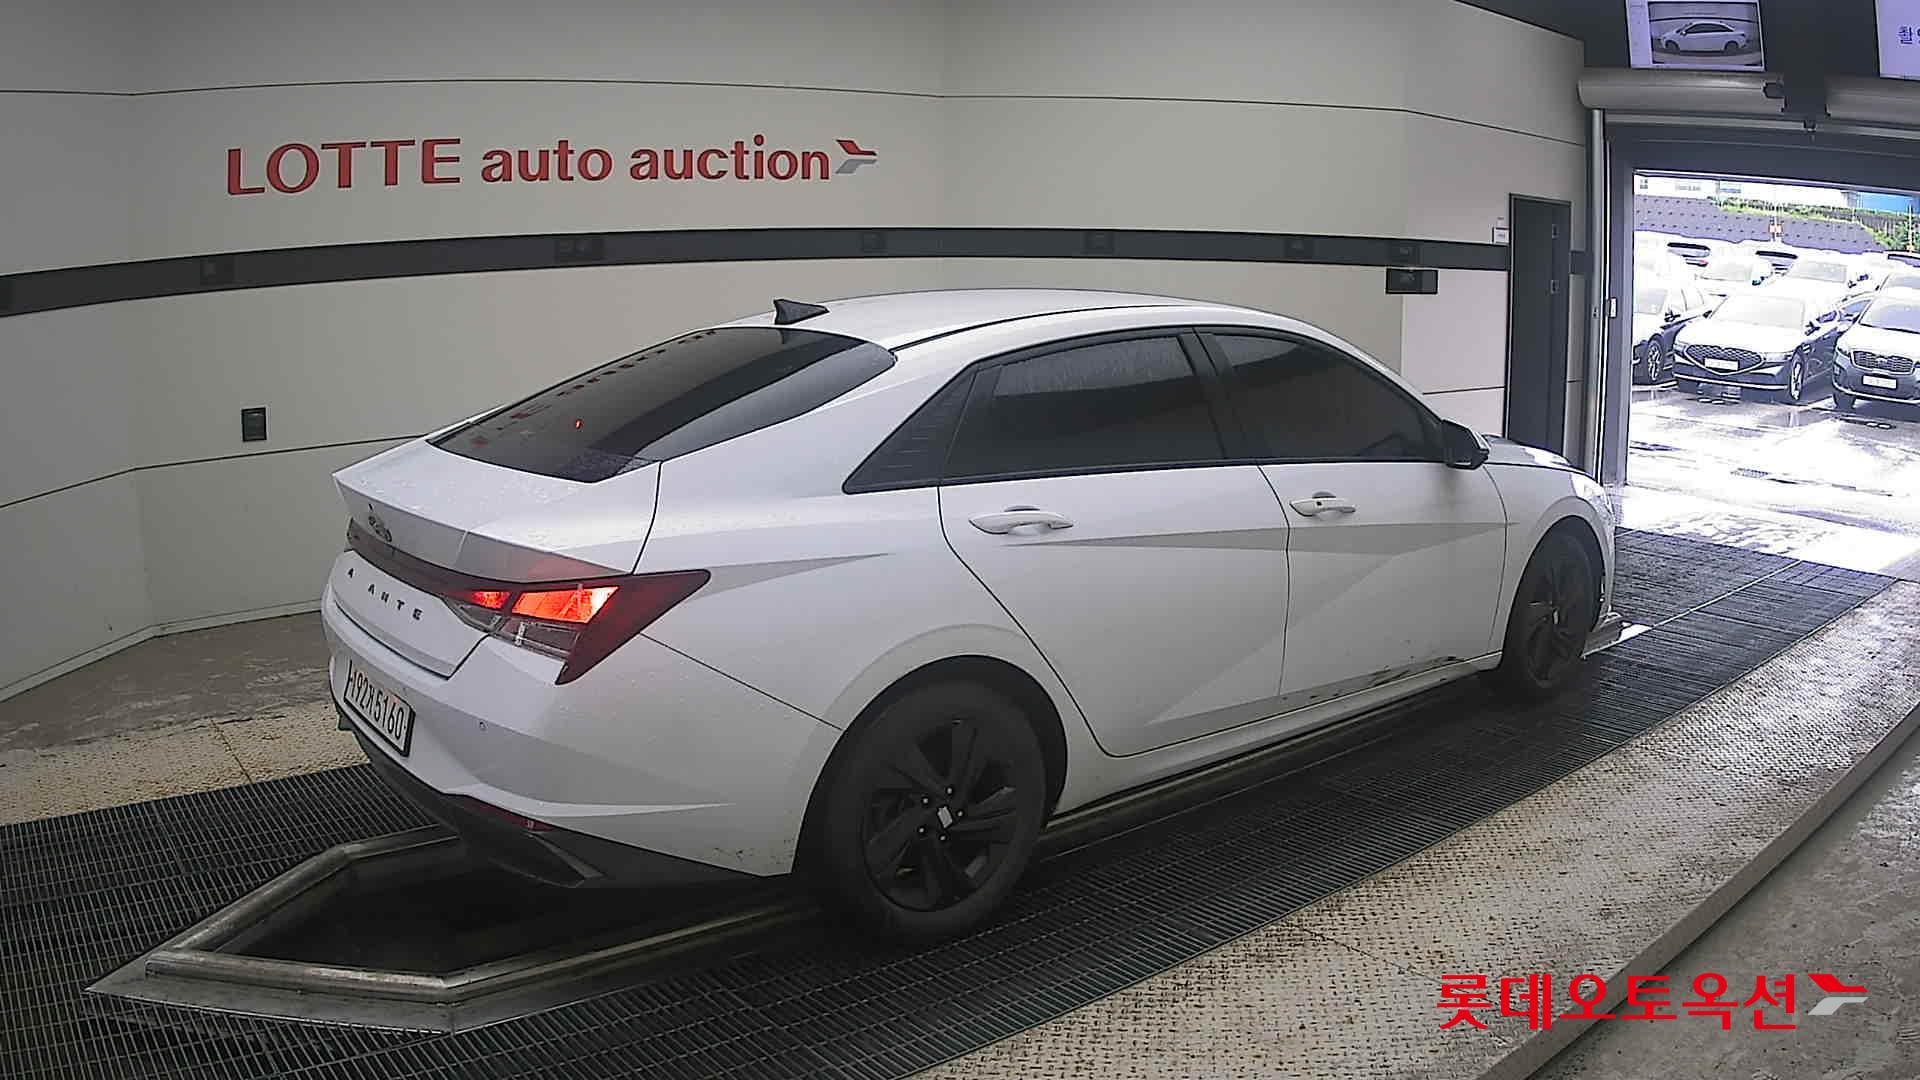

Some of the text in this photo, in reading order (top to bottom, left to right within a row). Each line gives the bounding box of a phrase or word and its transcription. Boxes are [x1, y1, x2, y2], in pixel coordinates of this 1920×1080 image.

[227, 135, 830, 195] LOTTE auto auction
[347, 567, 423, 621] AANTE
